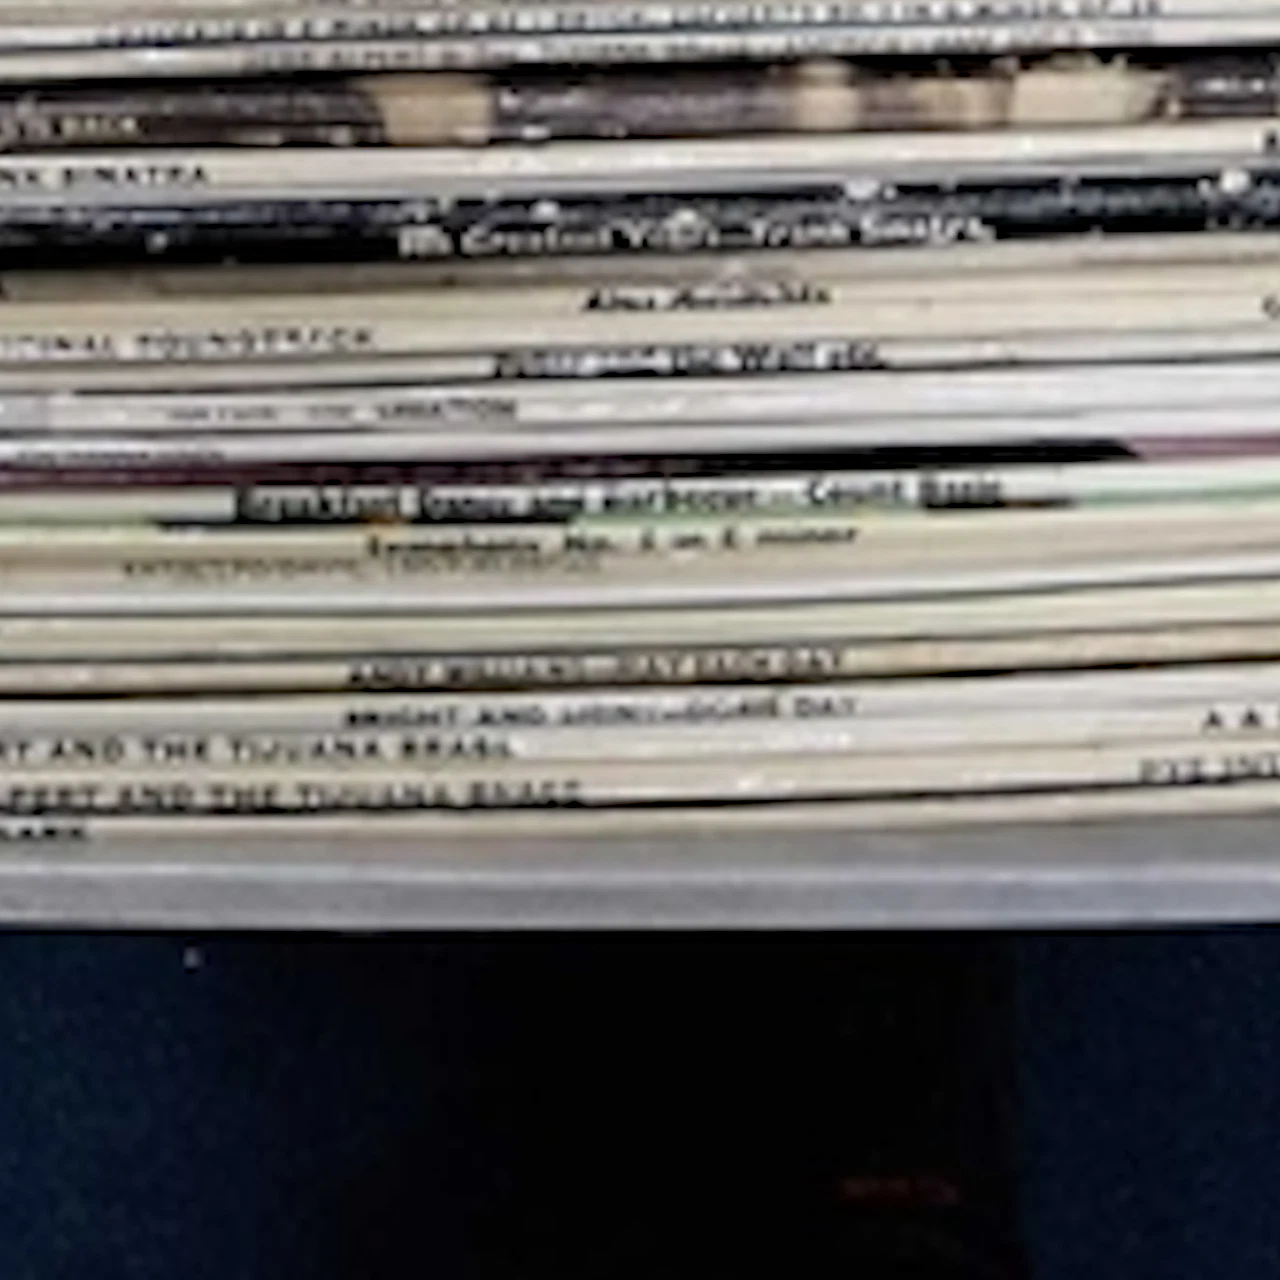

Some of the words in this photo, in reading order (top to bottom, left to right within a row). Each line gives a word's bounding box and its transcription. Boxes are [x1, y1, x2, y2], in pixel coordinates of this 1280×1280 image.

[793, 692, 858, 718] DAY
[50, 738, 126, 763] AND
[143, 737, 210, 762] THE
